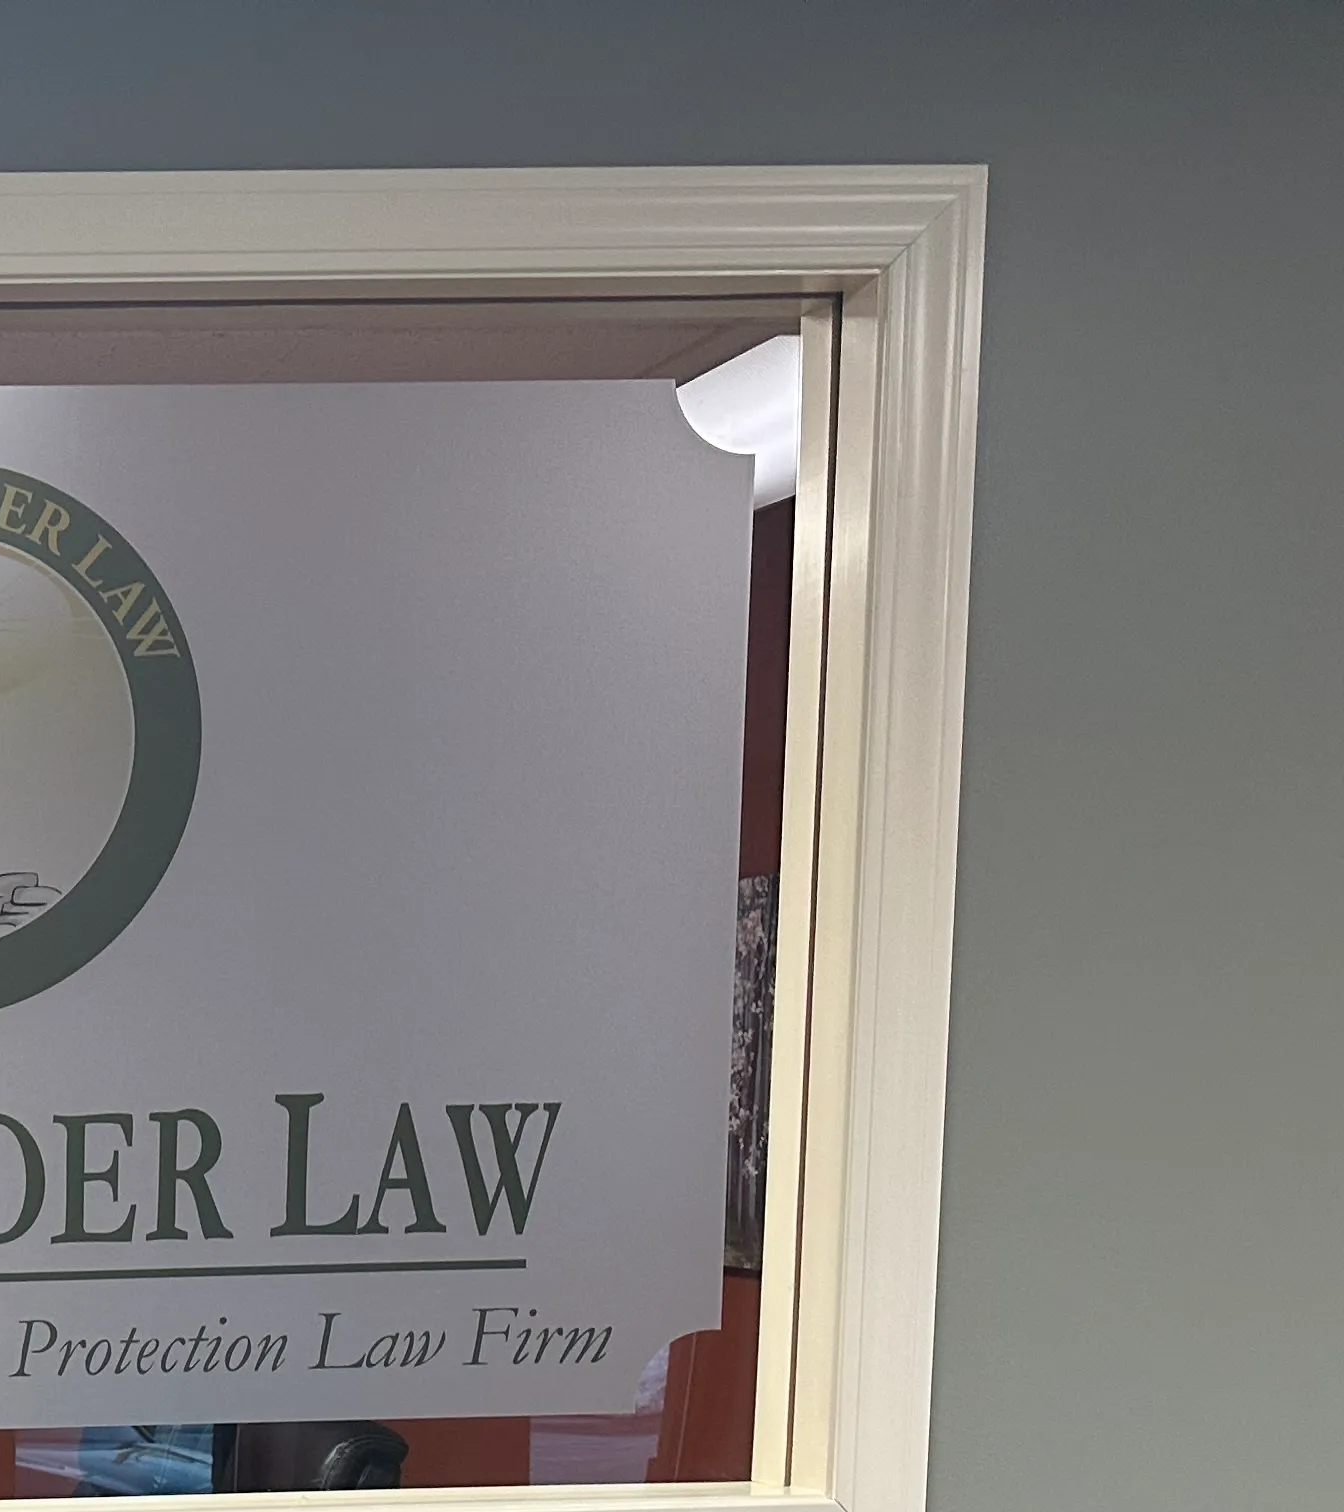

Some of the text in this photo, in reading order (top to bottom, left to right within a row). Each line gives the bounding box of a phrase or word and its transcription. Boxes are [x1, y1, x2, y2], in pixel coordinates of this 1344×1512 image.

[71, 533, 182, 661] LAW
[269, 1092, 562, 1238] LAW
[9, 1316, 289, 1378] Protection
[308, 1312, 446, 1371] Law
[462, 1307, 614, 1367] Firm
